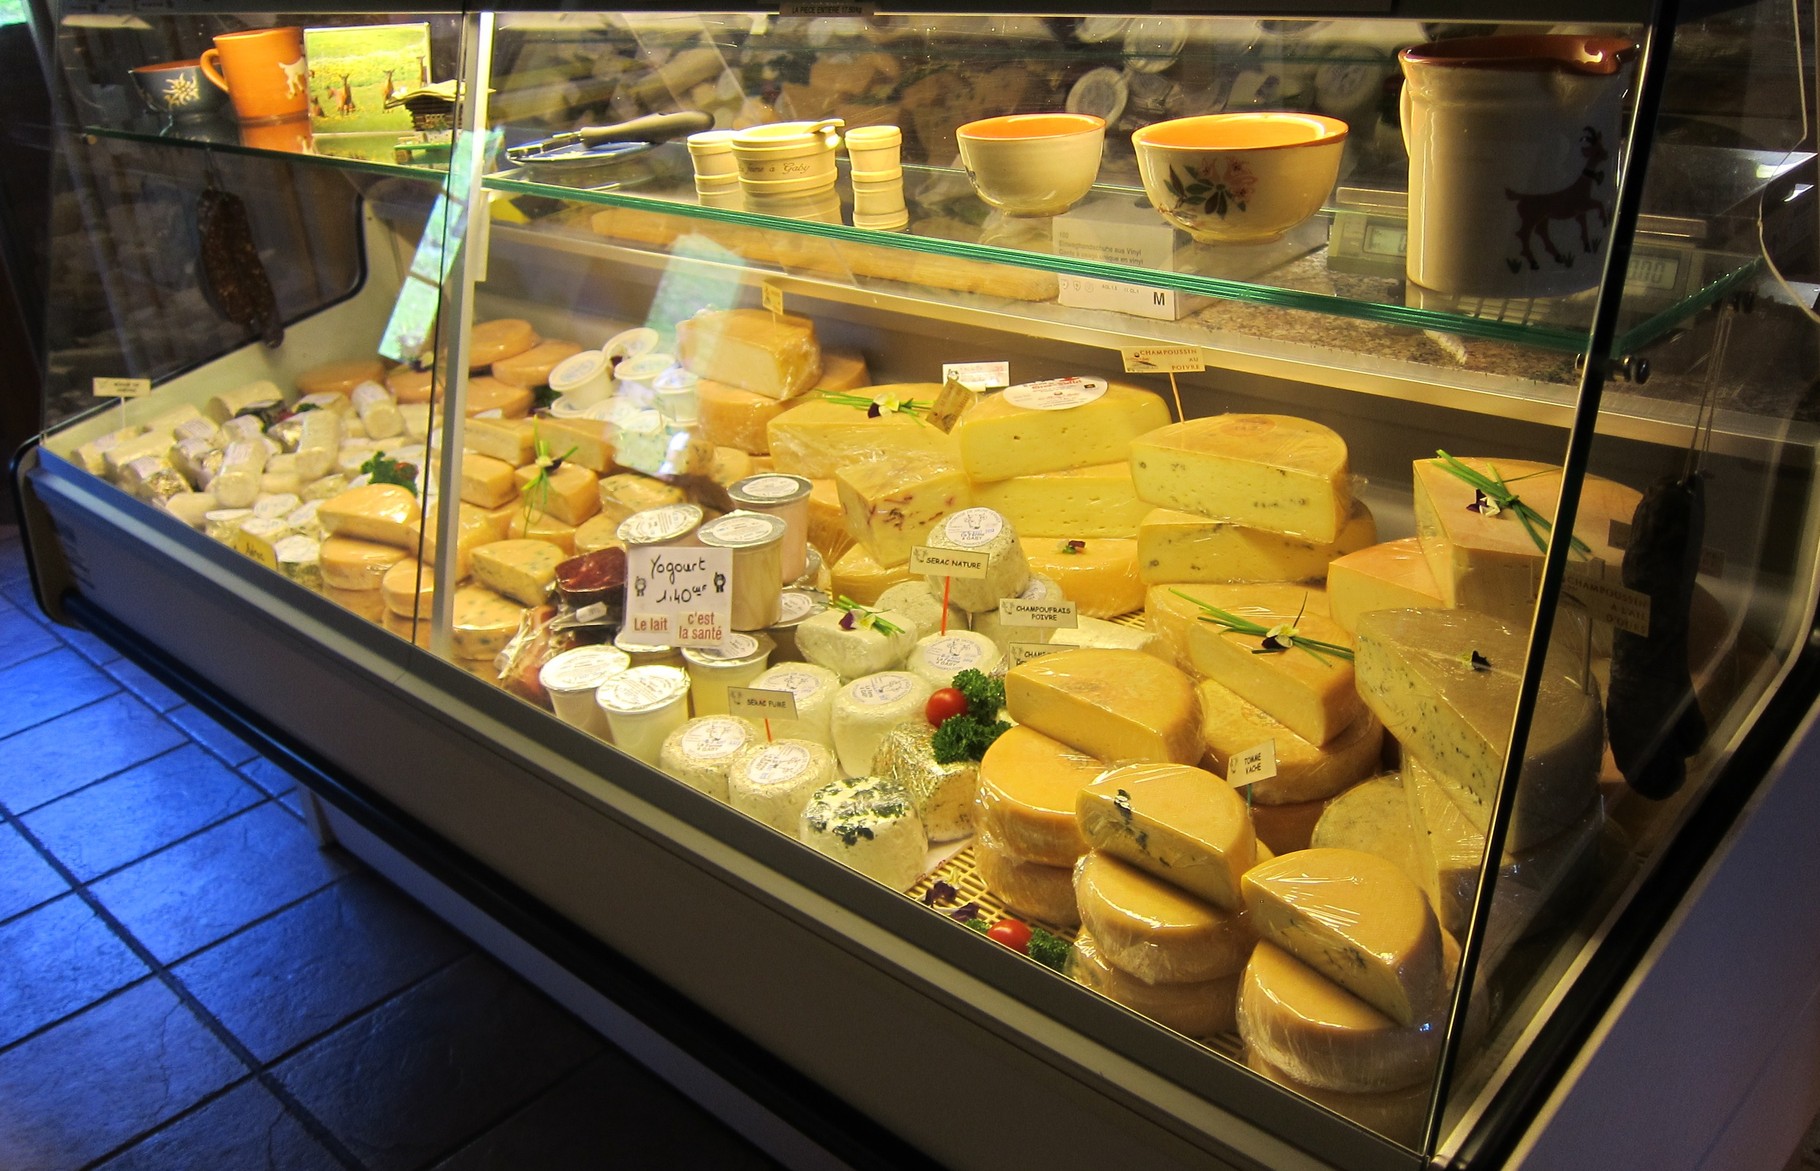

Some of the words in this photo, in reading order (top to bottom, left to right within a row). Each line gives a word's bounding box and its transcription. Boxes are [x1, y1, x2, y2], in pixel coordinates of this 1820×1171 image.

[782, 162, 811, 175] Gaby
[1126, 246, 1142, 257] Vinyl
[1129, 256, 1144, 266] vinyl
[1153, 291, 1165, 306] M
[1140, 348, 1198, 356] CHAMPOUSSIN
[651, 554, 706, 585] Yogourt
[926, 557, 950, 566] SERAC
[951, 560, 981, 570] NATURE
[1016, 605, 1071, 615] CHAMPOUFRAIS
[687, 611, 715, 626] c'est
[1031, 613, 1058, 622] POIVRE
[634, 617, 647, 632] Le
[650, 617, 668, 632] lait
[679, 625, 689, 640] la
[691, 625, 722, 641] santé
[747, 698, 767, 707] SERAC
[1244, 752, 1262, 766] TOMME
[1245, 762, 1262, 775] VACHE
